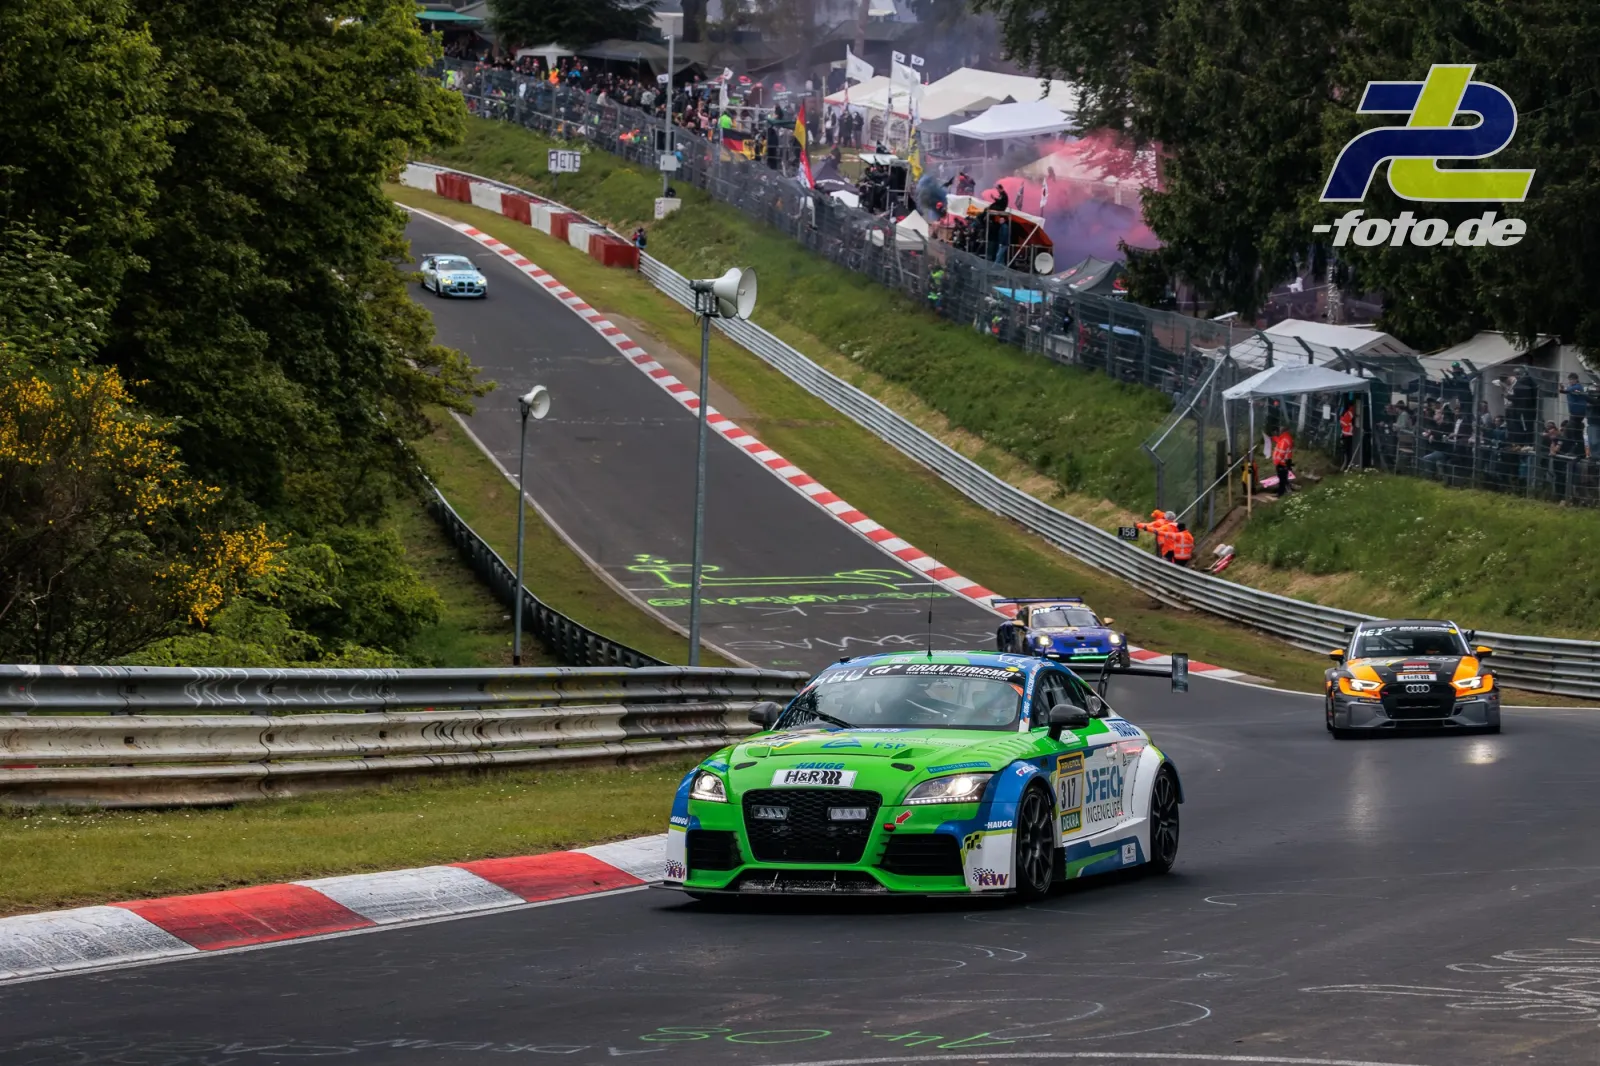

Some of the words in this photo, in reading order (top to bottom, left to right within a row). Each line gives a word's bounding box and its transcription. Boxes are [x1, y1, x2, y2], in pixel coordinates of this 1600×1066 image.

[1122, 527, 1136, 537] 158
[906, 664, 946, 673] GRAN
[949, 665, 1015, 678] TURISMO
[968, 673, 1008, 681] SIMULATOR
[874, 742, 906, 750] FSP
[796, 762, 845, 770] HAUGG
[784, 770, 821, 784] H&R
[1061, 778, 1076, 809] 317
[670, 815, 688, 825] HAUGG
[987, 820, 1013, 829] HAUGG
[1062, 813, 1080, 830] DEKRA
[978, 873, 1009, 886] KW
